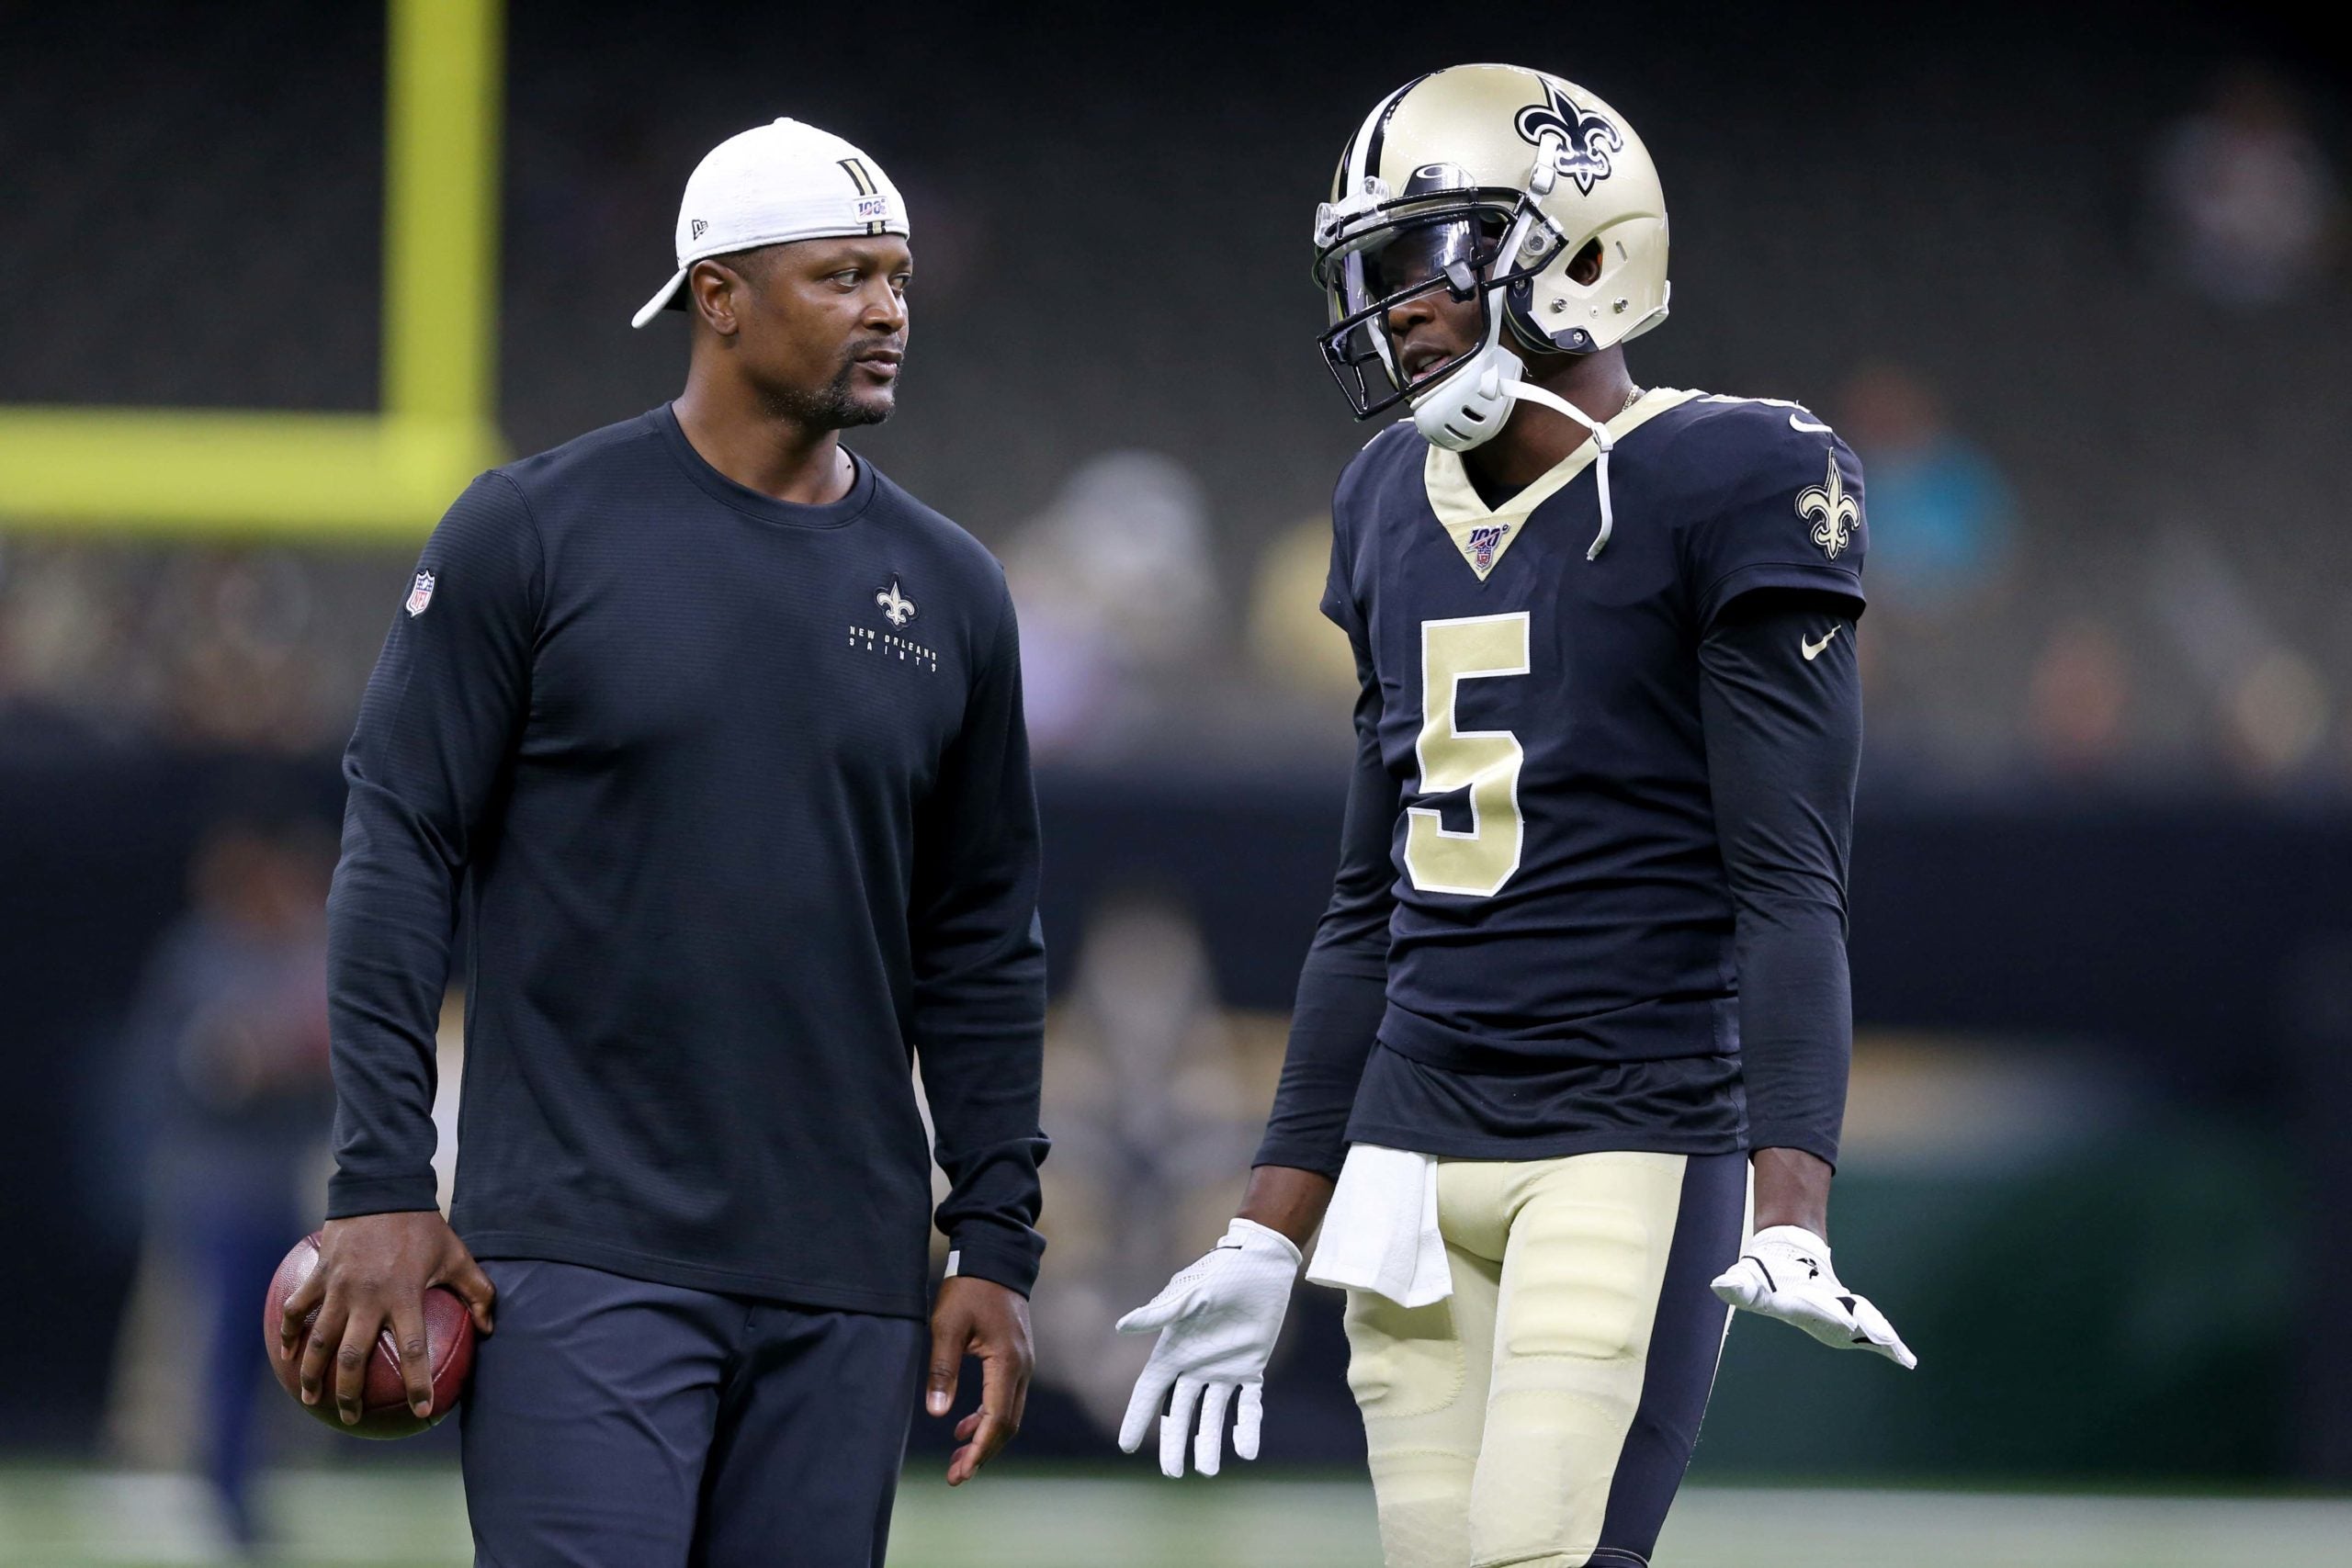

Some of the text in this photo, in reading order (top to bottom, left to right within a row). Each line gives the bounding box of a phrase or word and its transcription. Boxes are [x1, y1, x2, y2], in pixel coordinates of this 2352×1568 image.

[849, 626, 937, 660] NEW ORLEANS
[849, 637, 937, 672] SAINTS
[1403, 611, 1531, 897] 5
